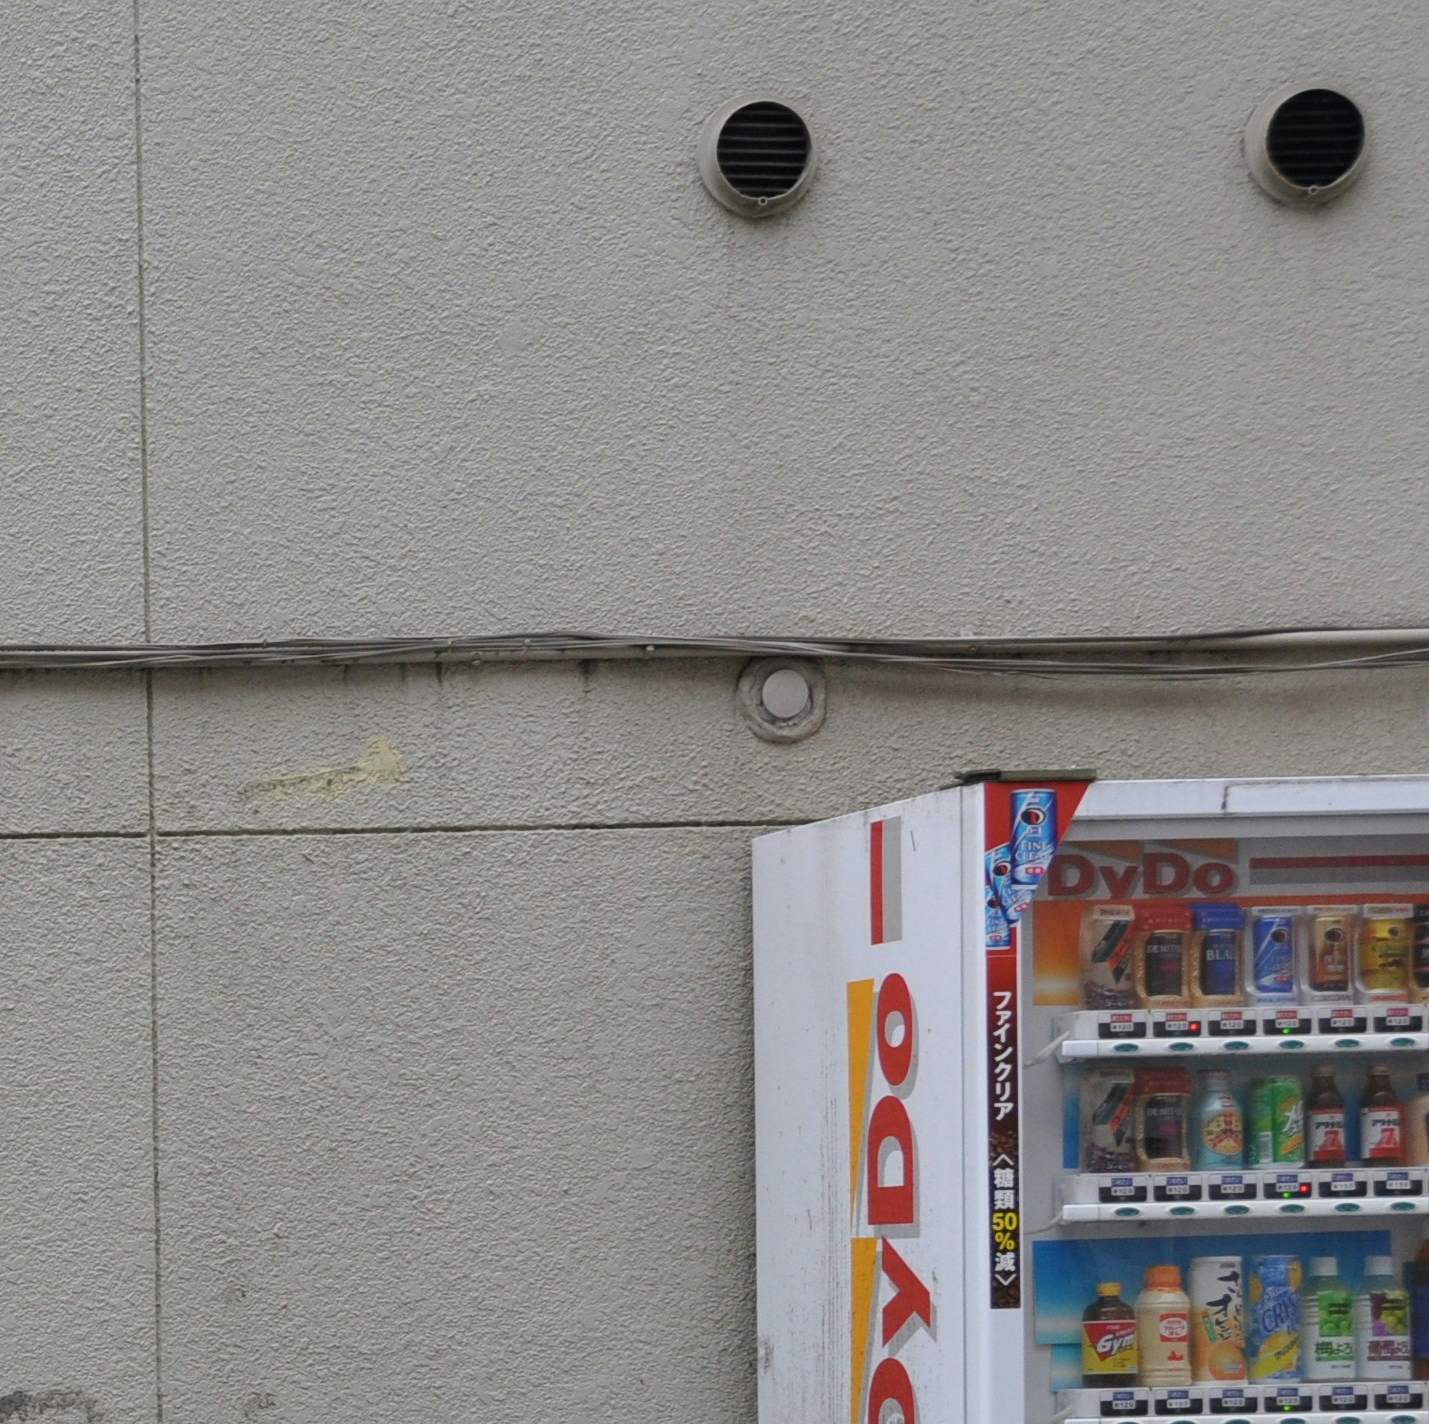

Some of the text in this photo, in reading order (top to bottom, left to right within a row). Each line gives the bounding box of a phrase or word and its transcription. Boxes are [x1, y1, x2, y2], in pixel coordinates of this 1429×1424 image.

[1047, 852, 1237, 900] DyDo
[992, 991, 1014, 1121] ファインクリア
